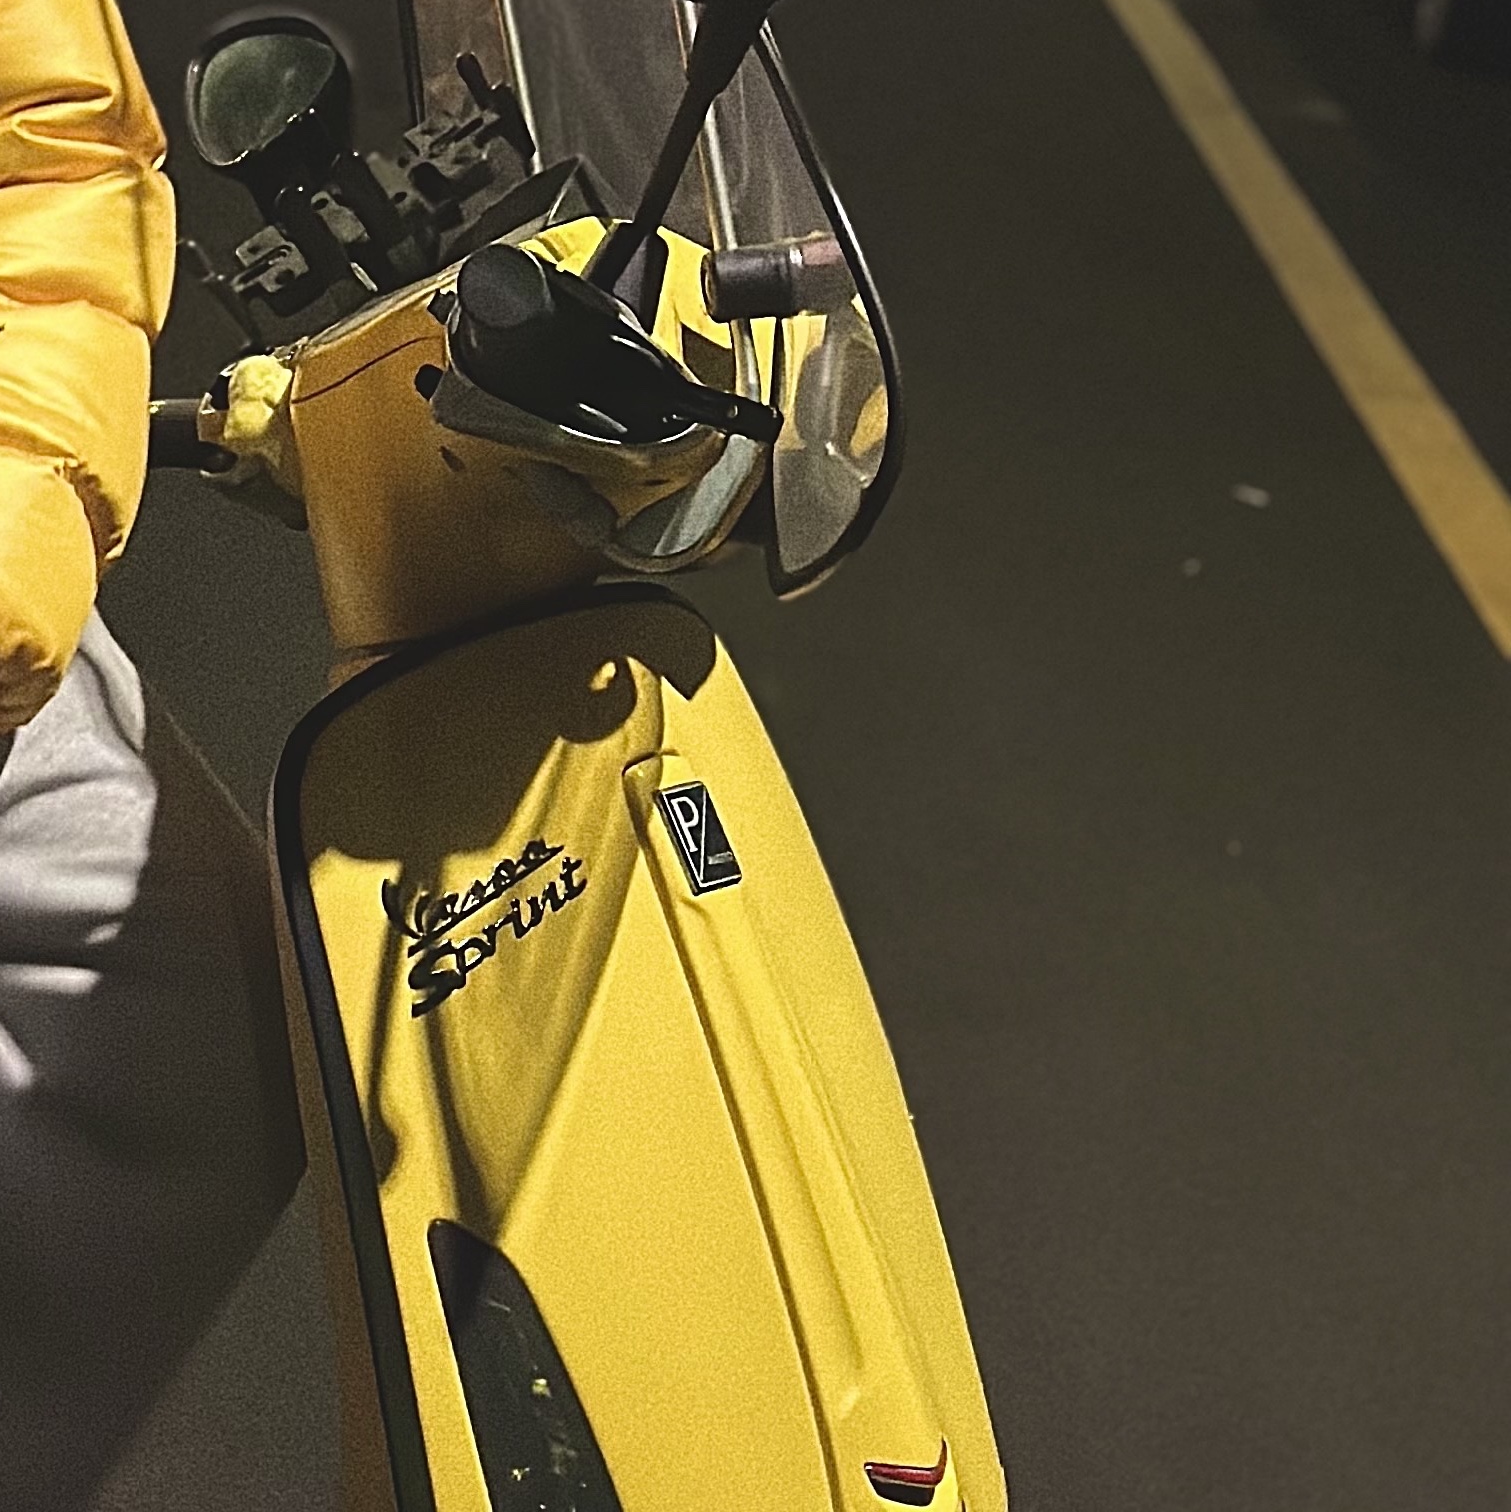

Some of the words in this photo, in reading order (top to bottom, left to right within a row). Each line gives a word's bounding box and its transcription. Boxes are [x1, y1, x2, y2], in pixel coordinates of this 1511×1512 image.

[670, 796, 699, 853] P
[381, 838, 565, 958] Vespa
[407, 856, 587, 1019] Sprint
